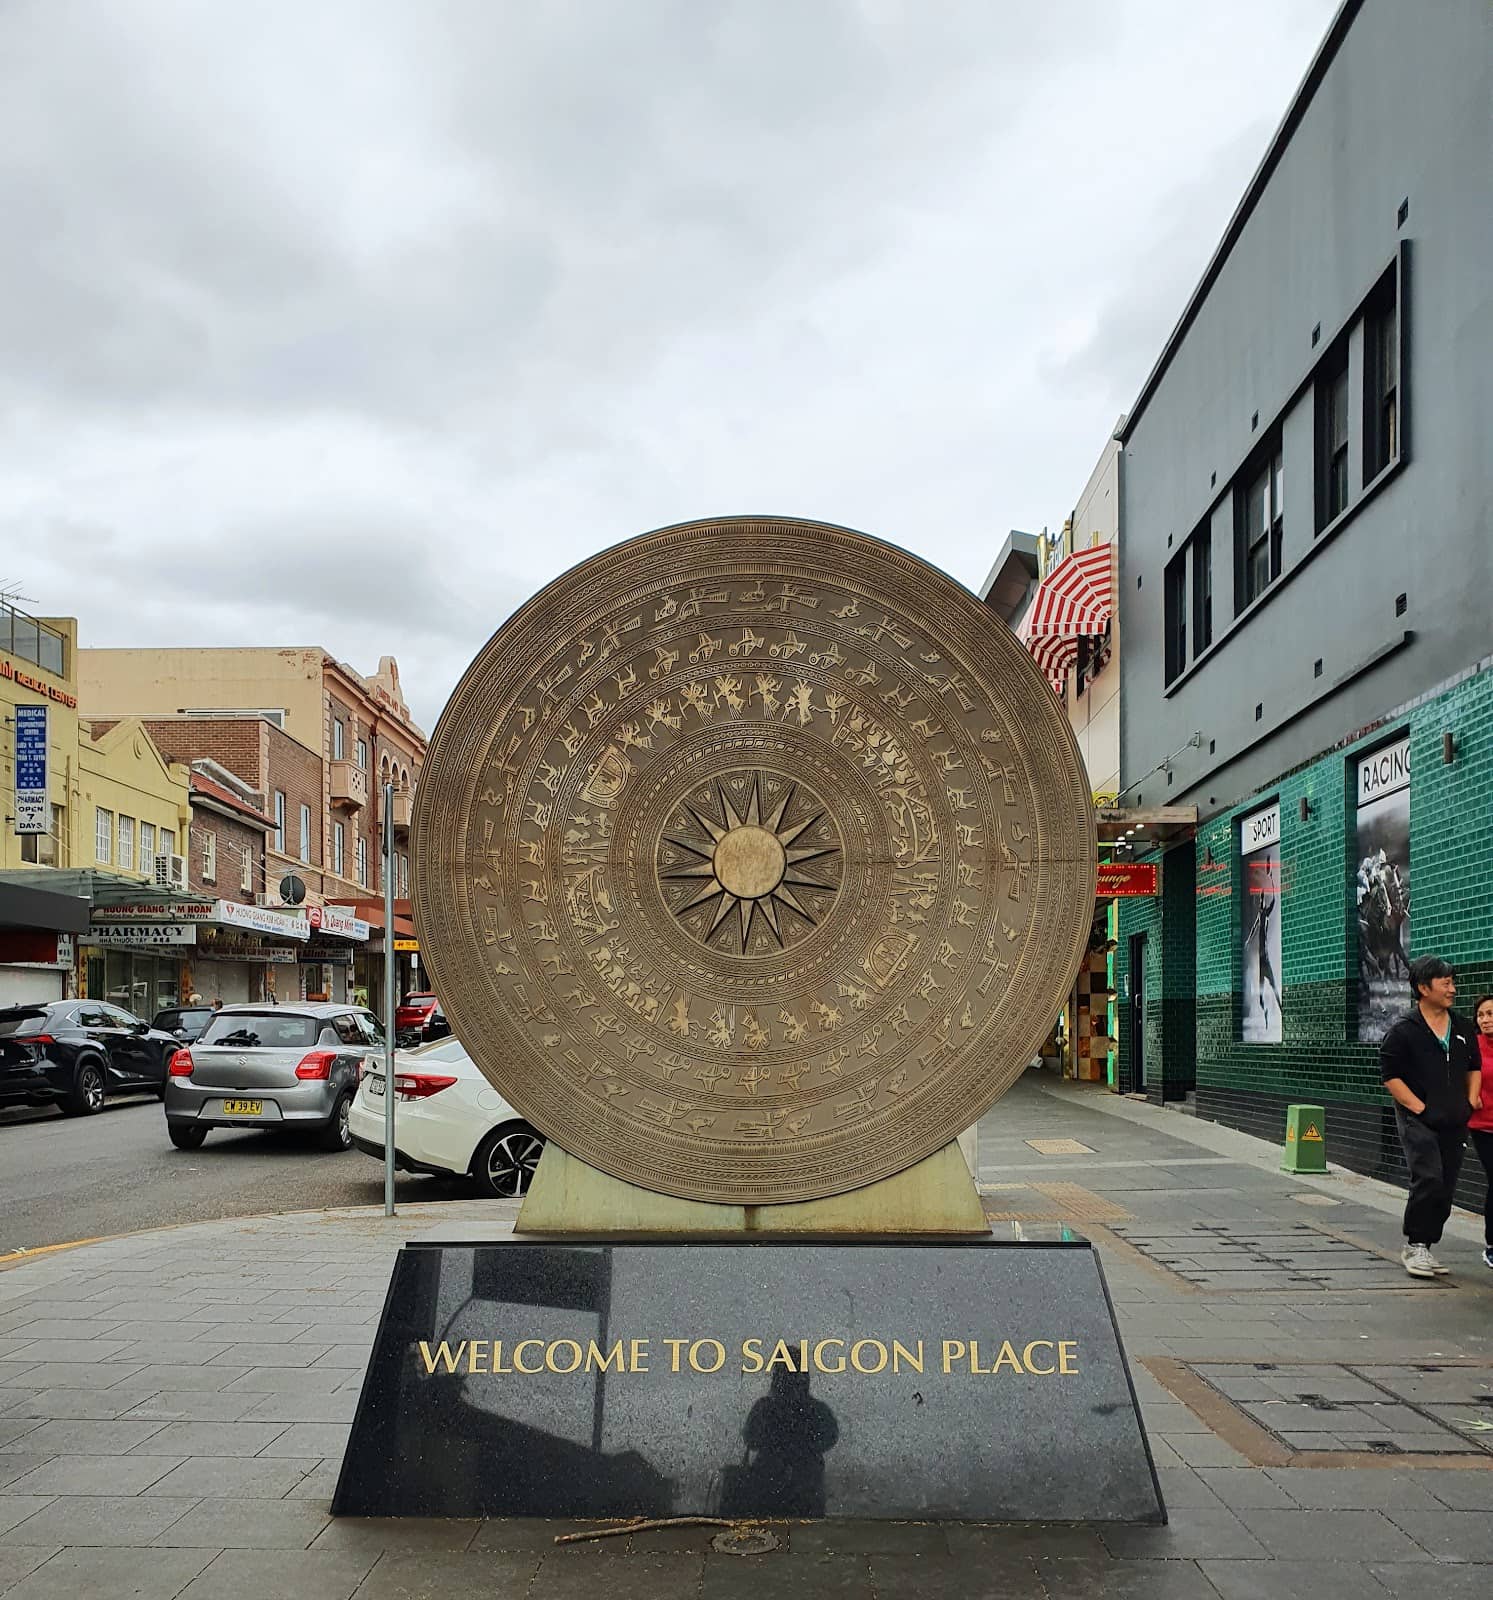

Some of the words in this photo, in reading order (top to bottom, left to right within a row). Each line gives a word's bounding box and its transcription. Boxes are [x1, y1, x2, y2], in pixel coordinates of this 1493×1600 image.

[16, 671, 48, 696] MEDICAL
[50, 688, 77, 708] CENTER
[18, 709, 46, 717] MEDICAL
[27, 813, 35, 821] 7
[1253, 812, 1277, 842] SPORT
[1096, 874, 1132, 889] unge
[137, 904, 165, 914] GIANG
[87, 927, 185, 936] PHARMACY
[418, 1338, 650, 1375] WELCOME
[662, 1338, 727, 1374] TO
[740, 1337, 925, 1374] SAIGON
[942, 1339, 1080, 1375] PLACE
